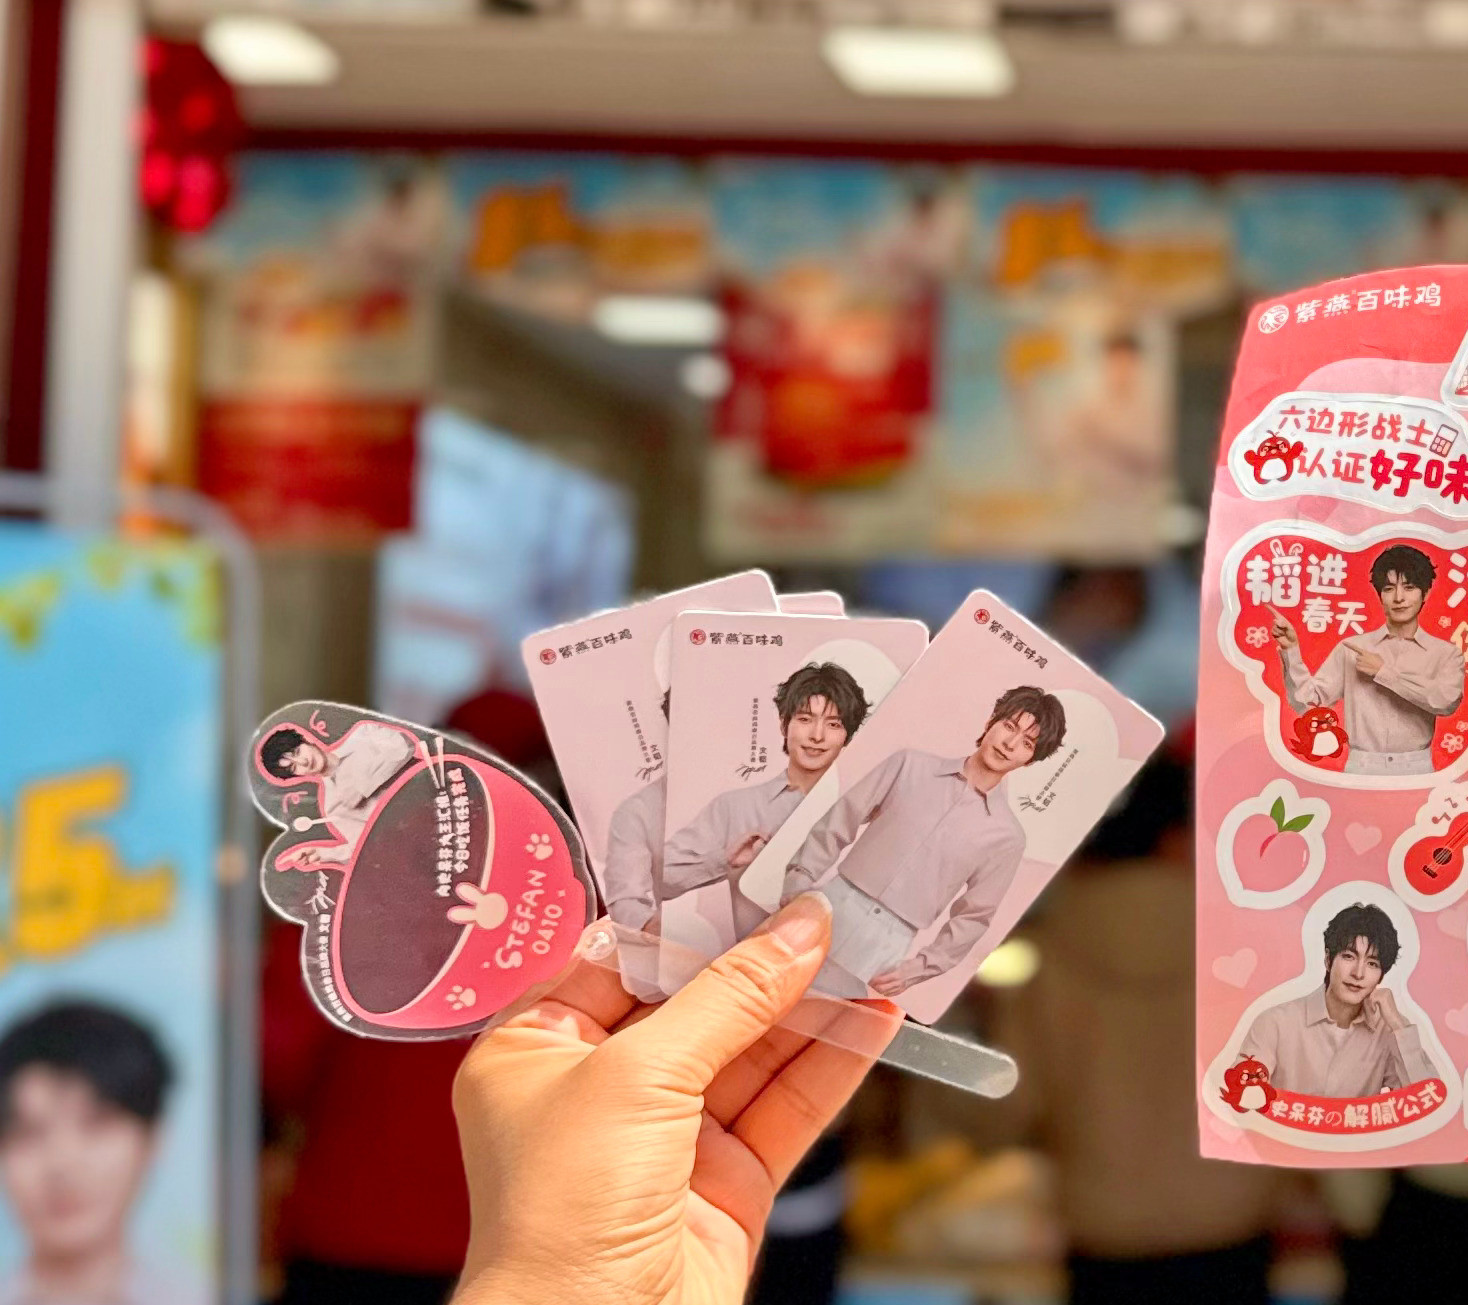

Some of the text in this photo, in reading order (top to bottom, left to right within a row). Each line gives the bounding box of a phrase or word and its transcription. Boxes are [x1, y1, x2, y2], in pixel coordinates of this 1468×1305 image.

[1295, 283, 1442, 324] 紫燕百味鸡
[1278, 405, 1433, 449] 六边形战士
[1302, 596, 1368, 635] 春天
[495, 869, 548, 970] STEFAN
[534, 903, 564, 956] 0410
